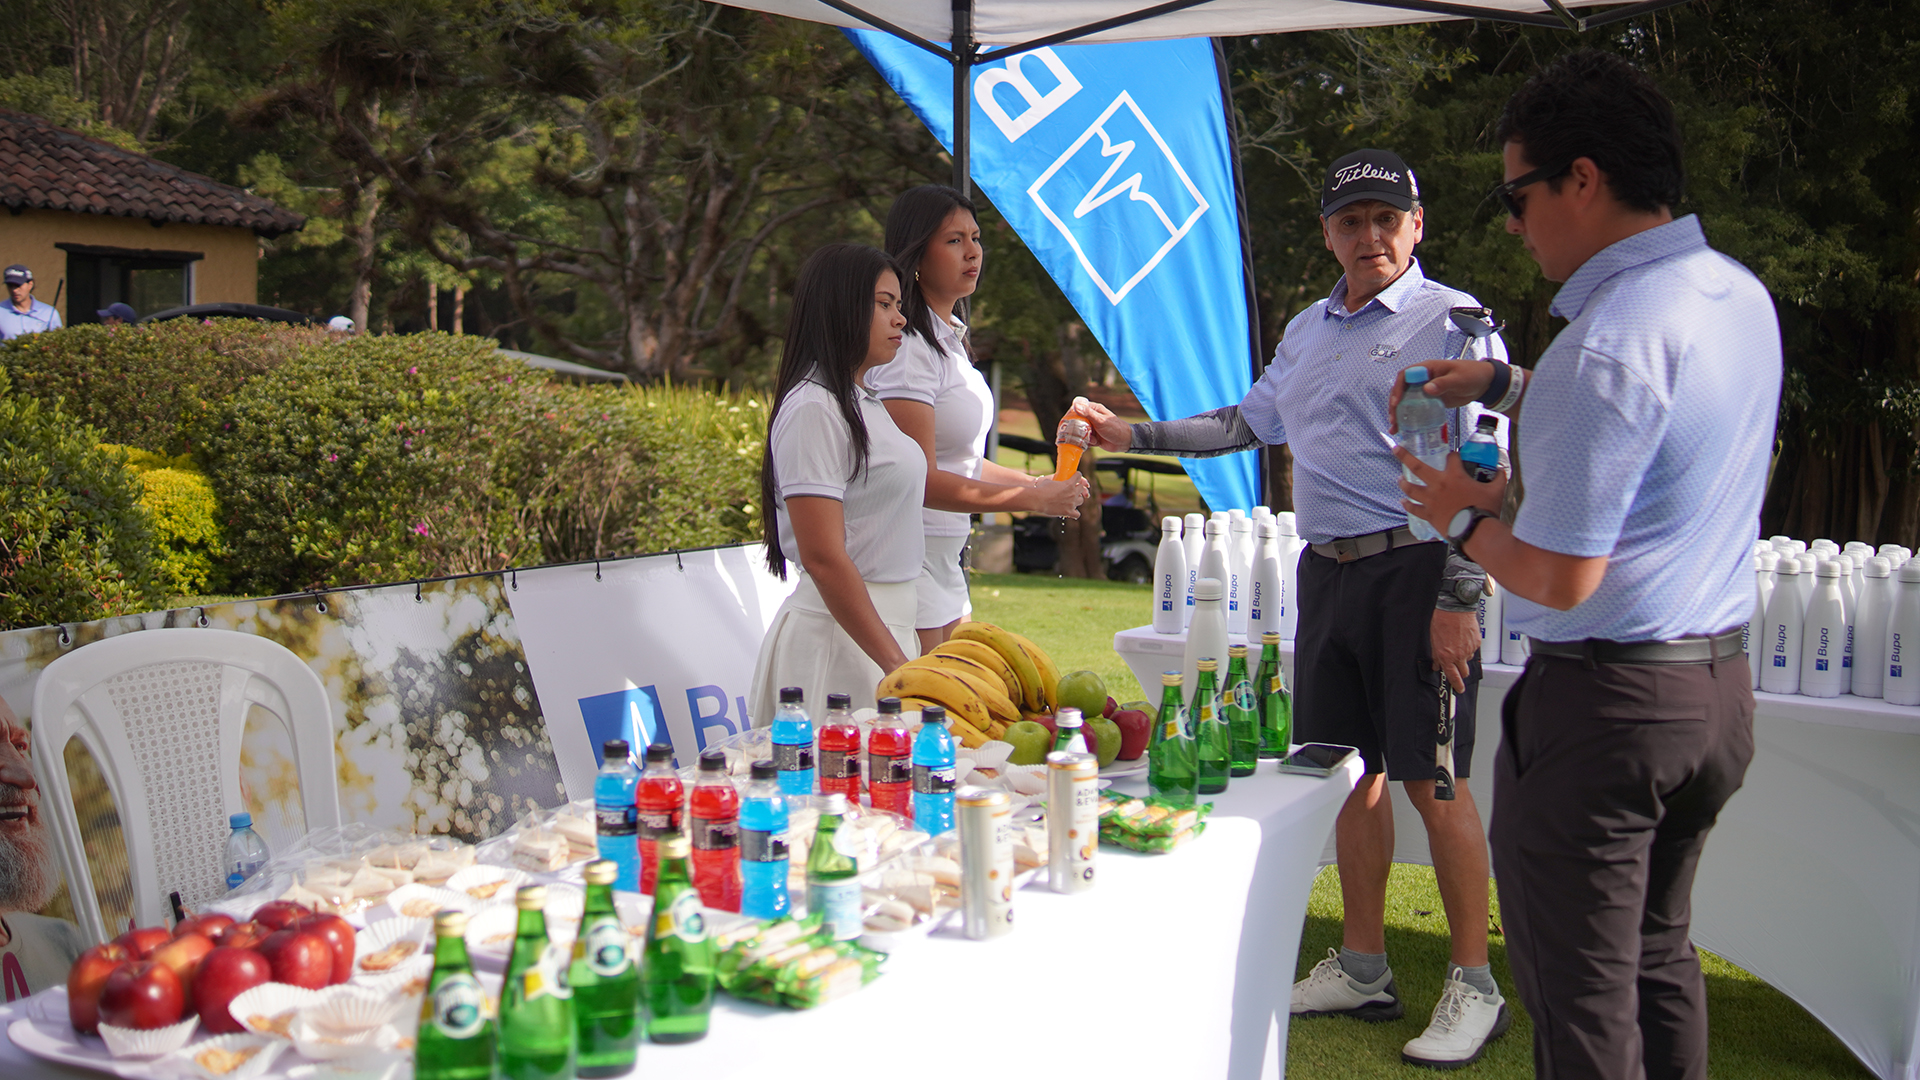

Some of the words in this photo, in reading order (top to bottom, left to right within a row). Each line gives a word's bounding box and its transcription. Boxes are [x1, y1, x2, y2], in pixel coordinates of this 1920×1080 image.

[1331, 162, 1400, 191] Titleist
[1370, 349, 1397, 358] GOLF
[1163, 574, 1172, 599] Bupa
[1188, 570, 1196, 593] Bupa
[1230, 574, 1238, 598] Bupa
[1253, 581, 1261, 607] Bupa
[1775, 624, 1787, 653] Bupa
[1817, 627, 1829, 656] Bupa
[1845, 625, 1853, 653] Bupa
[1891, 633, 1902, 662] Bupa
[1438, 670, 1448, 700] Stro
[1437, 700, 1447, 737] Super
